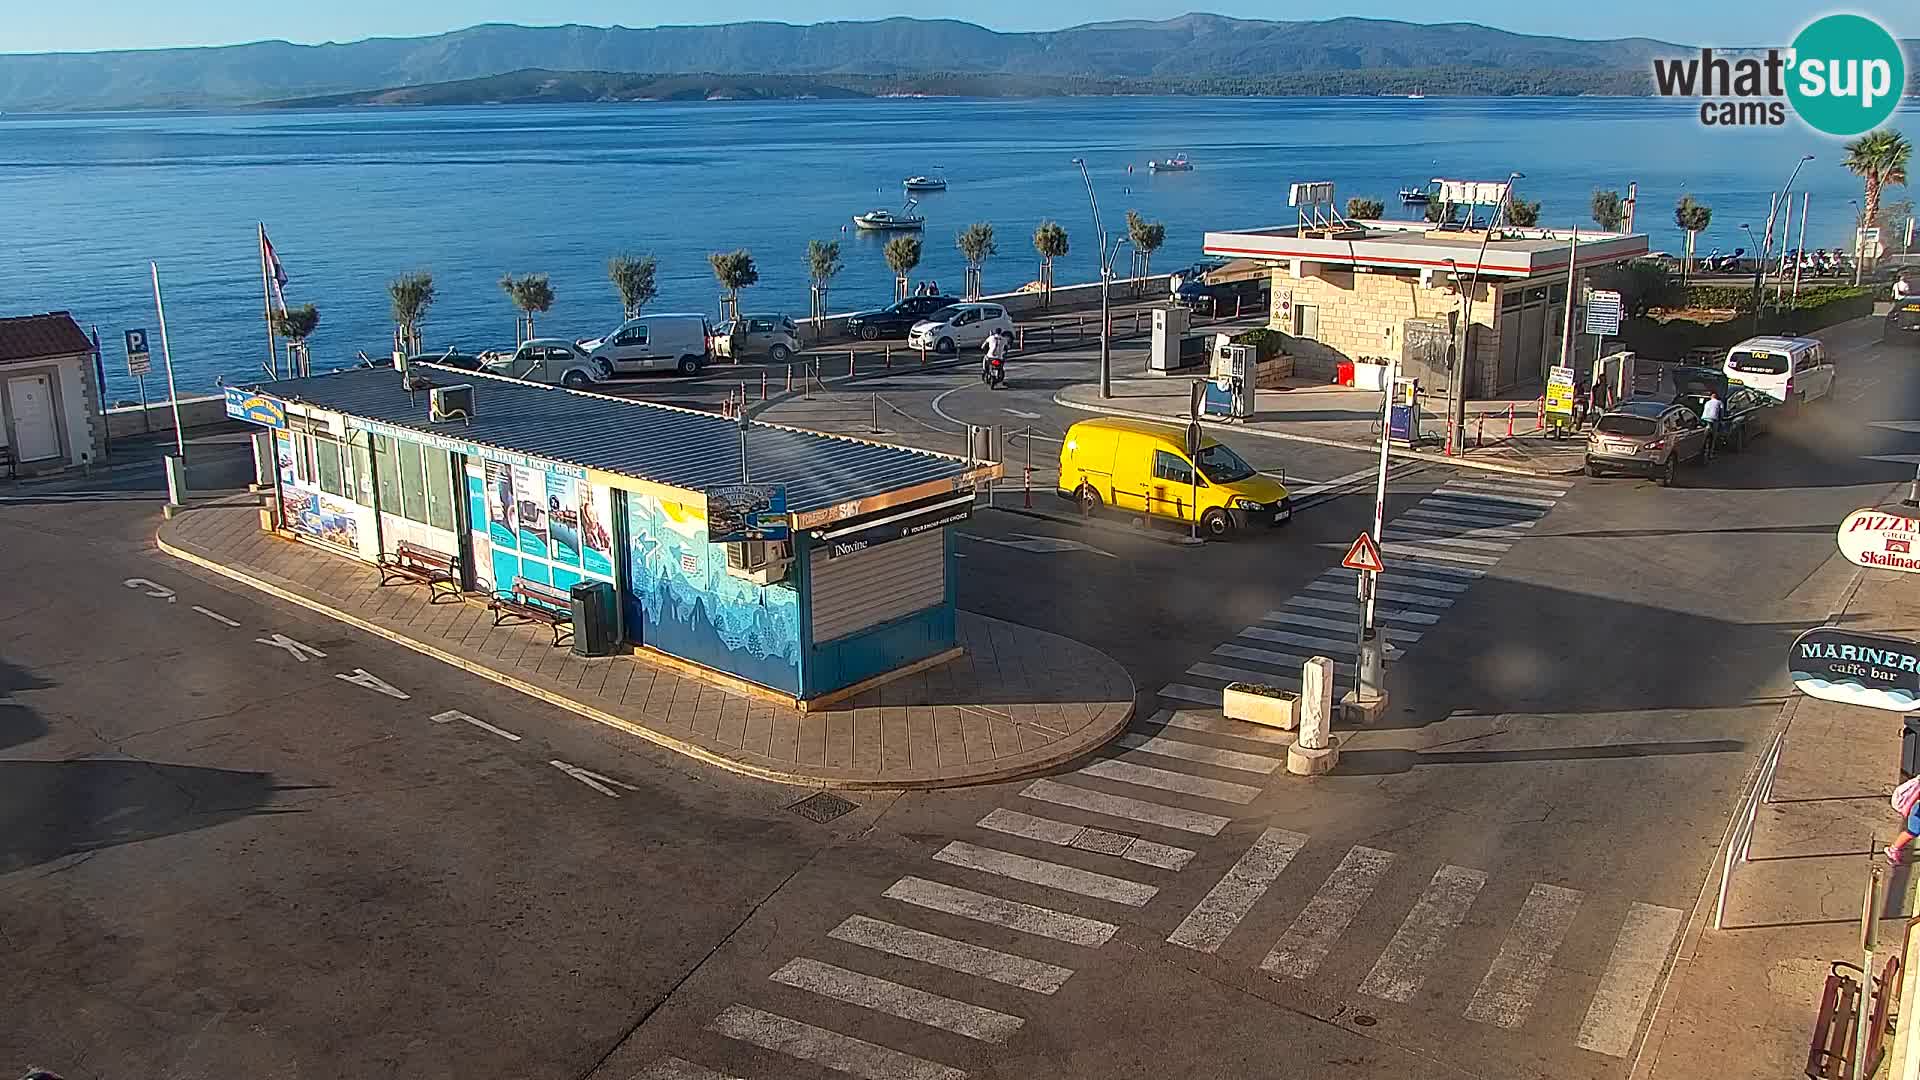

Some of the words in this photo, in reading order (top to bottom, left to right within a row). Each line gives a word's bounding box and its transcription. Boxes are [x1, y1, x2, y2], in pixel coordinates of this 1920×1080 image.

[129, 333, 142, 351] P
[1751, 351, 1769, 360] TAXI
[493, 450, 526, 466] STATION
[528, 457, 554, 473] TICKET
[555, 463, 583, 478] OFFICE
[949, 512, 967, 522] CHOICE
[1849, 516, 1920, 534] PIZZE
[1829, 662, 1866, 677] caffe
[1870, 666, 1898, 682] bar
